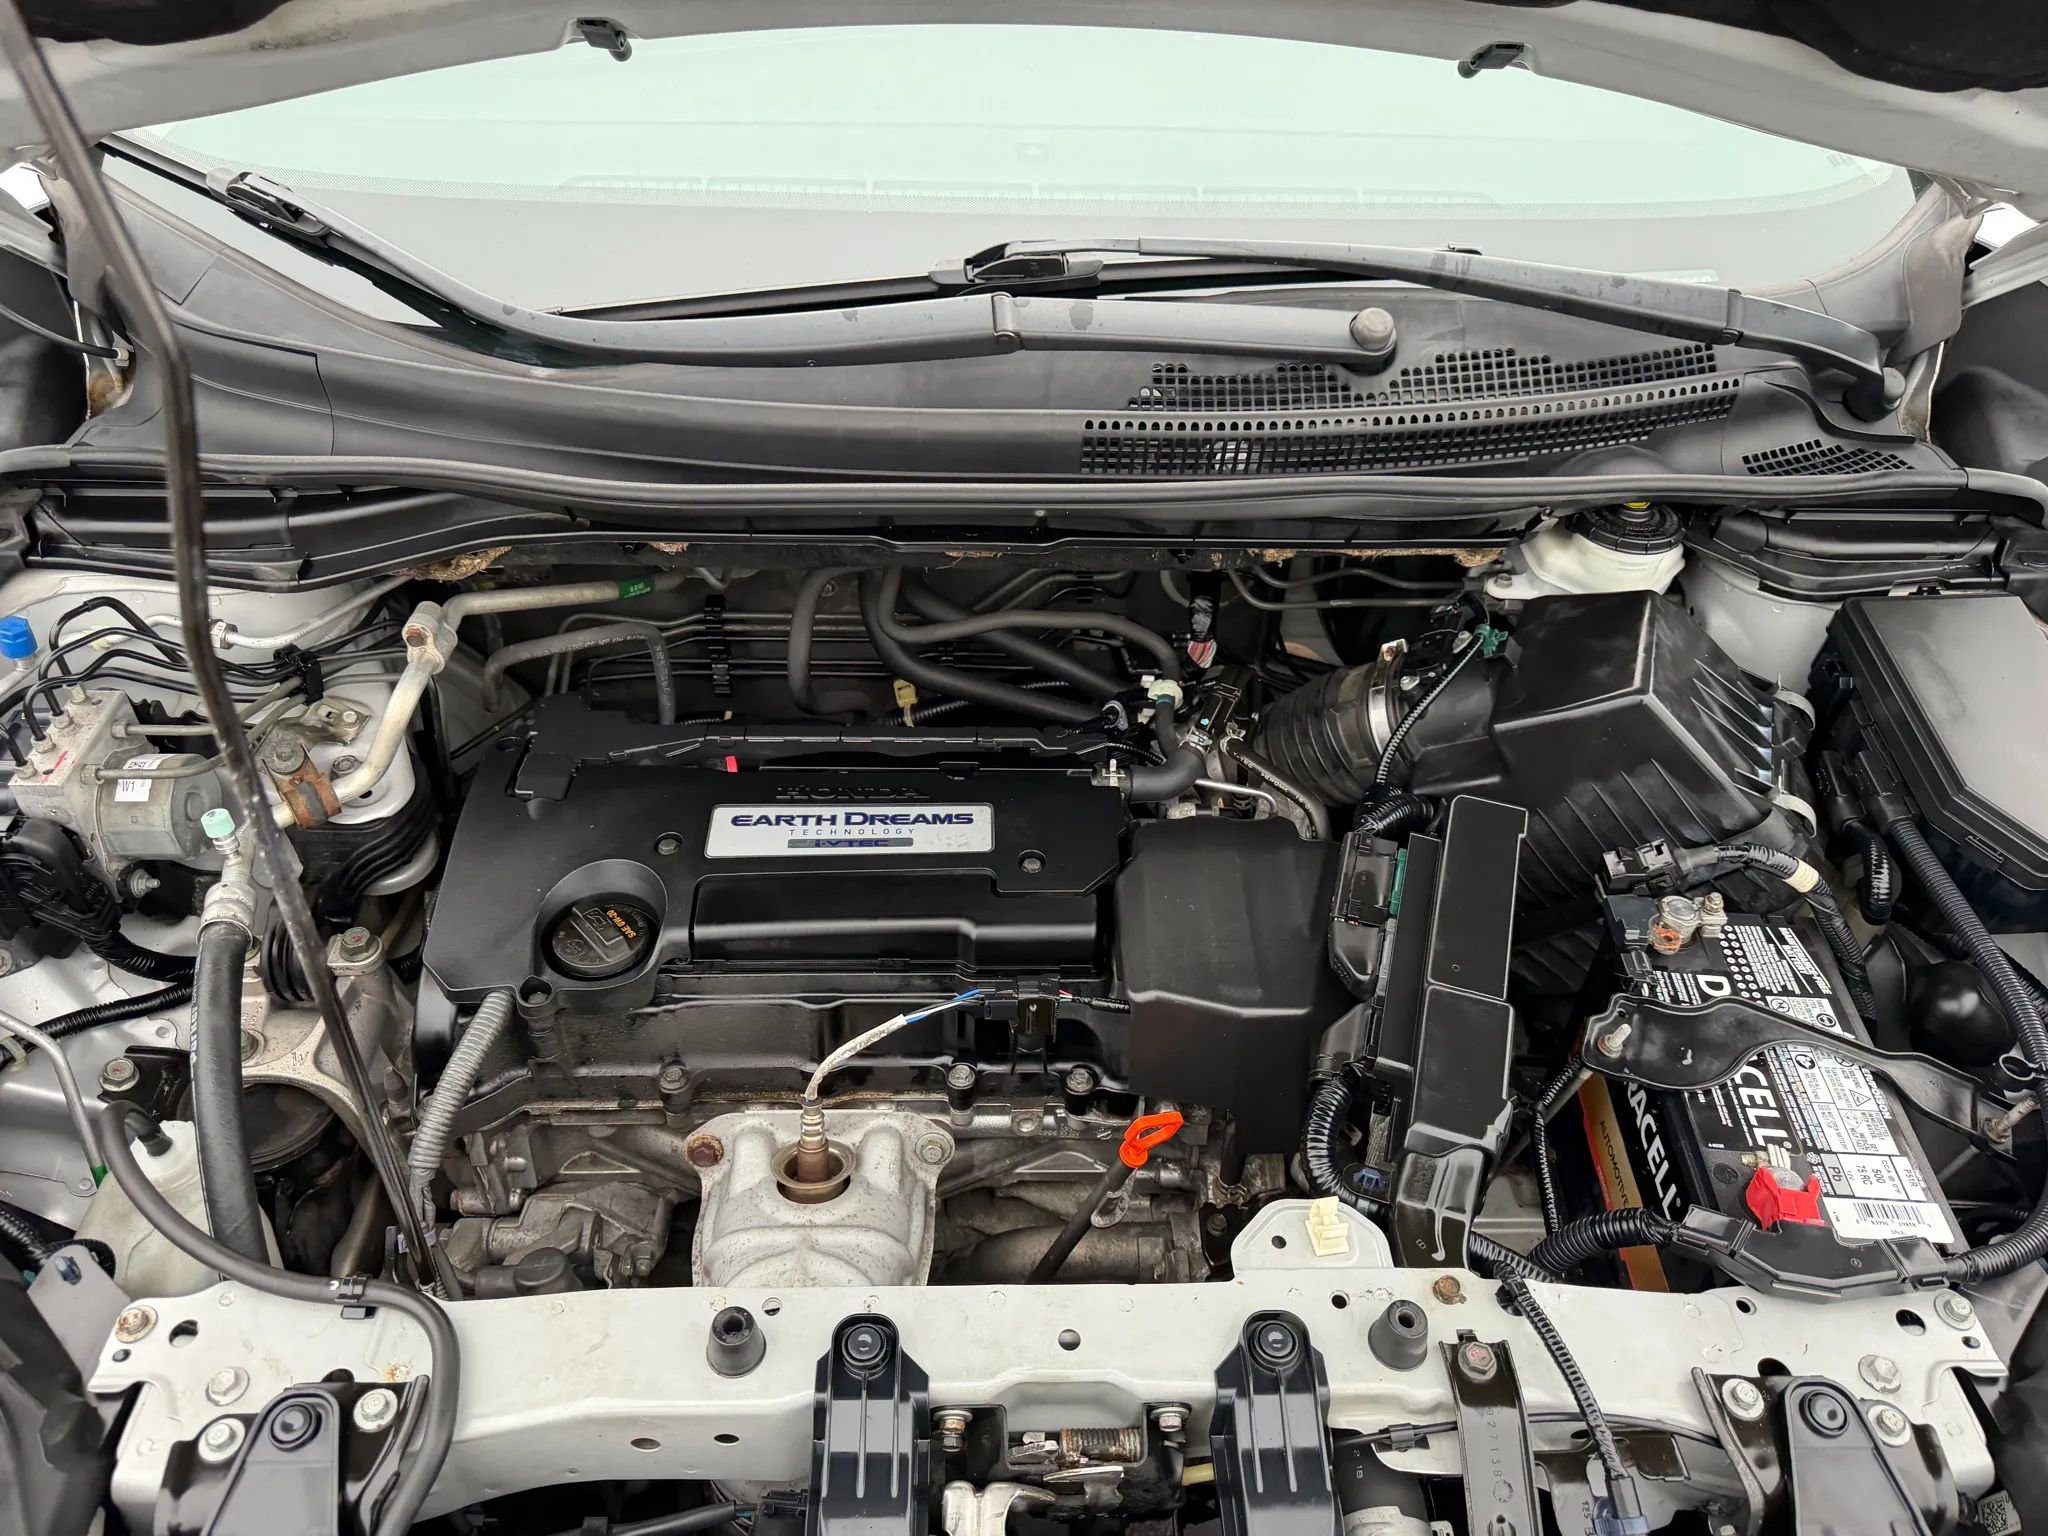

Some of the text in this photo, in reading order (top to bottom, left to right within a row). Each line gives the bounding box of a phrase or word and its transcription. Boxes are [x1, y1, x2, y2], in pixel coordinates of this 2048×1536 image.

[776, 786, 930, 800] HONDA
[731, 811, 975, 827] EARTH DREAMS
[789, 828, 915, 836] TECHNOLOGY
[621, 925, 637, 939] SAE
[1778, 927, 1833, 995] MAINTENANCE-FREE
[1627, 1081, 1678, 1221] RACELL
[1600, 1119, 1630, 1208] AUTOMOTIVE
[1880, 1159, 1892, 1173] CCA
[1827, 1166, 1845, 1181] Pb
[1859, 1175, 1873, 1185] RC
[1870, 1168, 1886, 1183] 500
[1902, 1169, 1918, 1187] P51R
